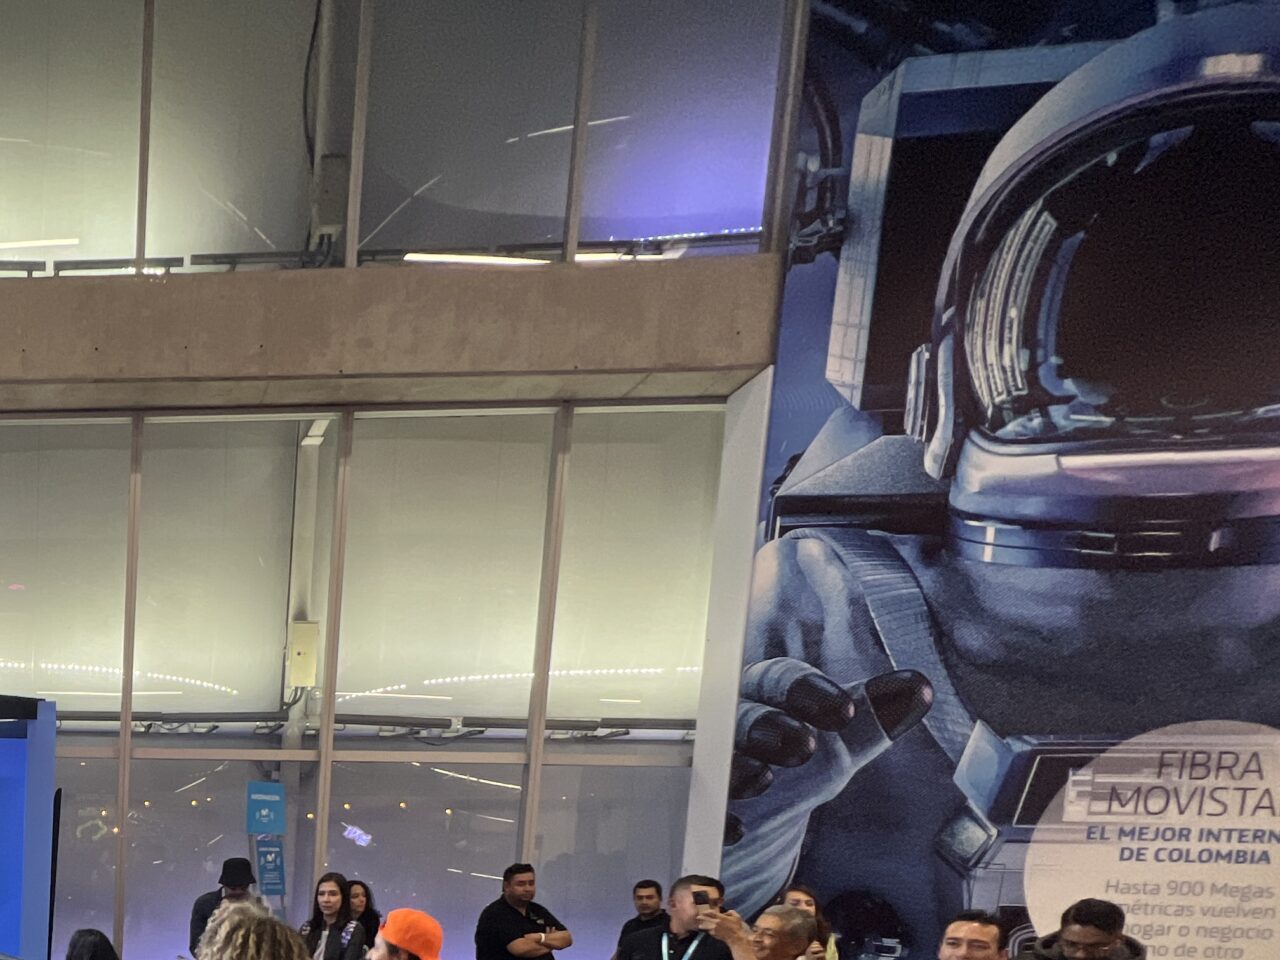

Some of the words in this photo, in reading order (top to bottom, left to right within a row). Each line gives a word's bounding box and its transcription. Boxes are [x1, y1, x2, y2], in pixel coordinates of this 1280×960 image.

[1157, 750, 1264, 780] FIBRA
[1107, 785, 1280, 816] MOVISTA
[1086, 826, 1110, 841] EL
[1118, 826, 1192, 842] MEJOR
[1119, 847, 1149, 862] DE
[1154, 848, 1271, 864] COLOMBIA
[1105, 879, 1161, 896] Hasta
[1167, 880, 1205, 897] 900
[1210, 882, 1276, 902] Megas
[1201, 903, 1276, 919] vuelven
[1178, 925, 1190, 937] o
[1195, 925, 1274, 942] negocio
[1174, 942, 1198, 958] de
[1203, 945, 1244, 960] otro
